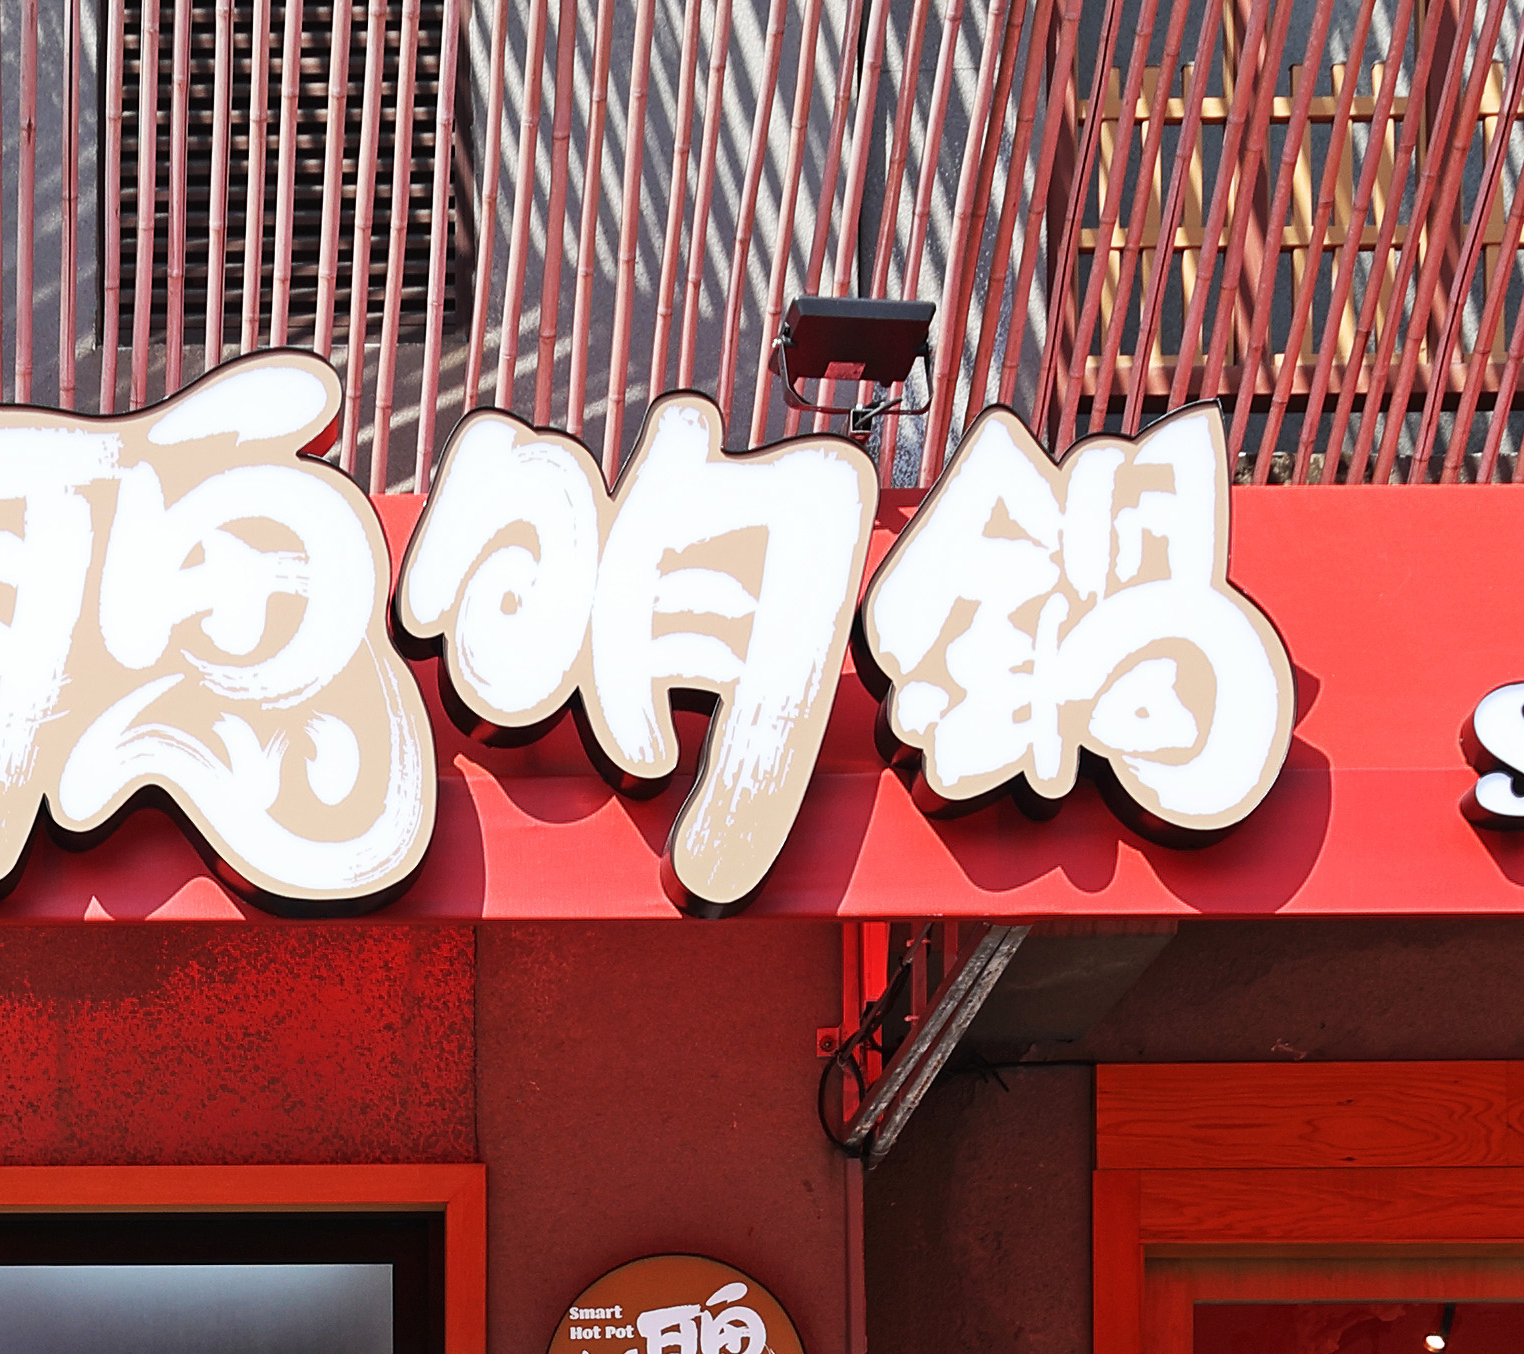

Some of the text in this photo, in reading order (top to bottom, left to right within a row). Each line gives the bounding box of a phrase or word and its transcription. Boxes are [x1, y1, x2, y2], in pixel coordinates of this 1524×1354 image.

[569, 1305, 622, 1320] Smart
[570, 1325, 634, 1340] Hot Pot
